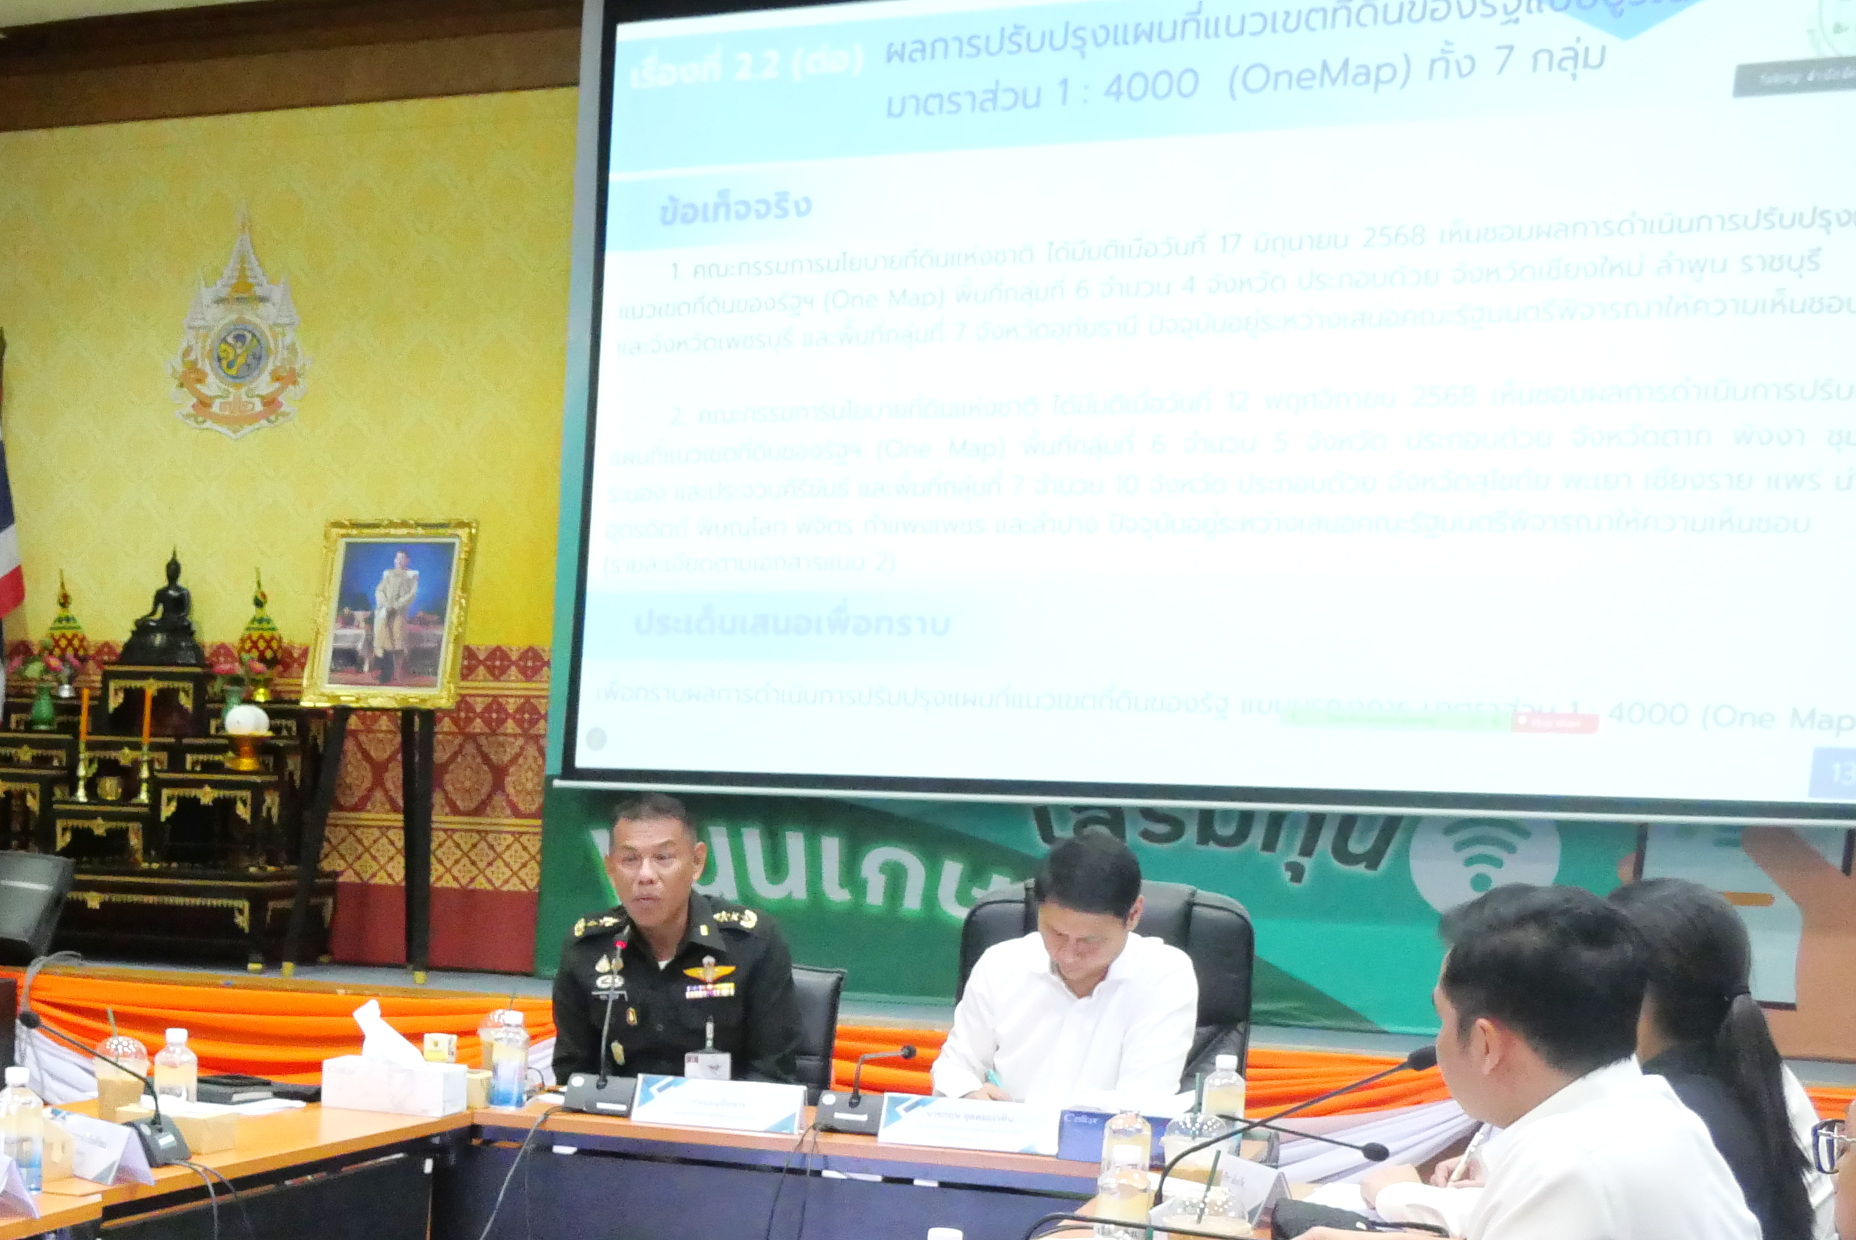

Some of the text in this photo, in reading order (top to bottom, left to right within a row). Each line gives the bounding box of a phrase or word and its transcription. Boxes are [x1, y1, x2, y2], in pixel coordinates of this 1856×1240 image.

[886, 78, 1042, 120] มาตราส่วน
[1103, 67, 1199, 105] 4000
[1494, 44, 1516, 76] 7
[1529, 37, 1608, 82] กลุ่ม
[1219, 232, 1242, 255] 17
[1362, 224, 1427, 249] 2568
[1074, 278, 1090, 300] 6
[1226, 391, 1250, 413] 12
[1411, 383, 1477, 407] 2568
[1608, 701, 1689, 727] 4000
[1788, 706, 1856, 735] Map
